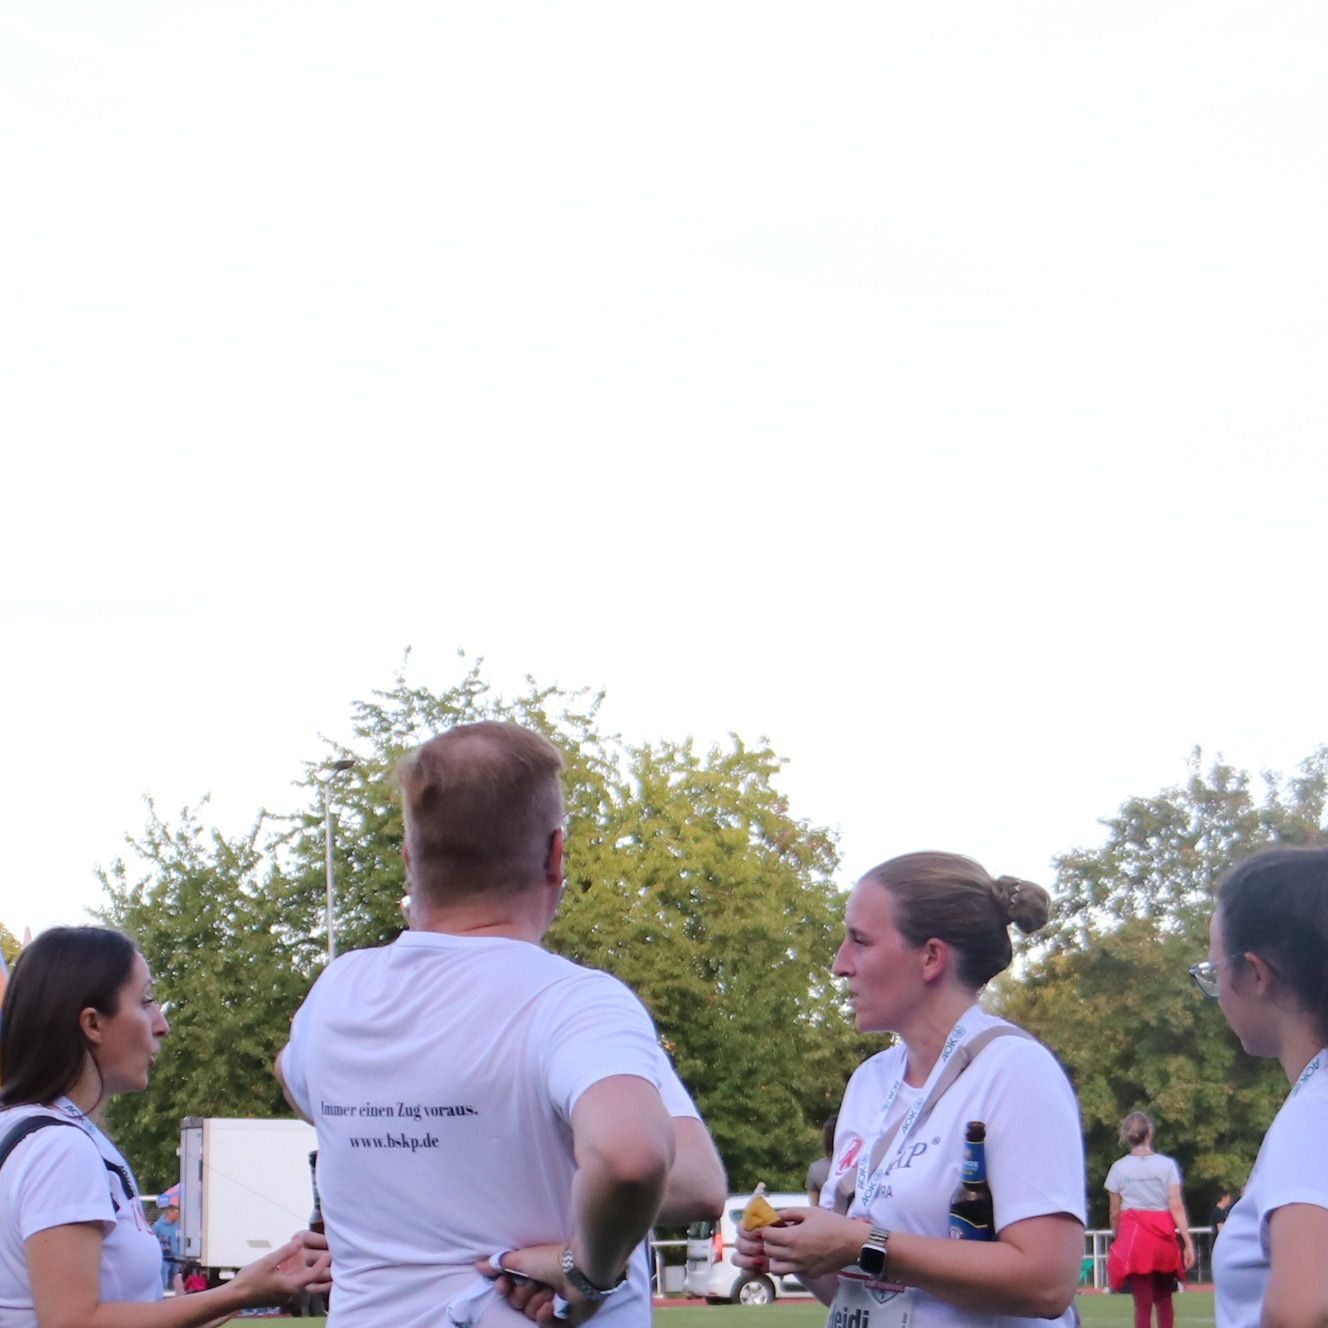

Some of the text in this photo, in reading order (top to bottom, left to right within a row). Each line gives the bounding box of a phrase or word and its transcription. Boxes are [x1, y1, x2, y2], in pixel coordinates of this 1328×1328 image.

[942, 1038, 960, 1063] AOK
[321, 1101, 479, 1121] Immer einen Zug voraus.
[902, 1110, 917, 1134] AOK
[349, 1133, 439, 1152] www.bskp.de
[862, 1183, 877, 1208] AOK
